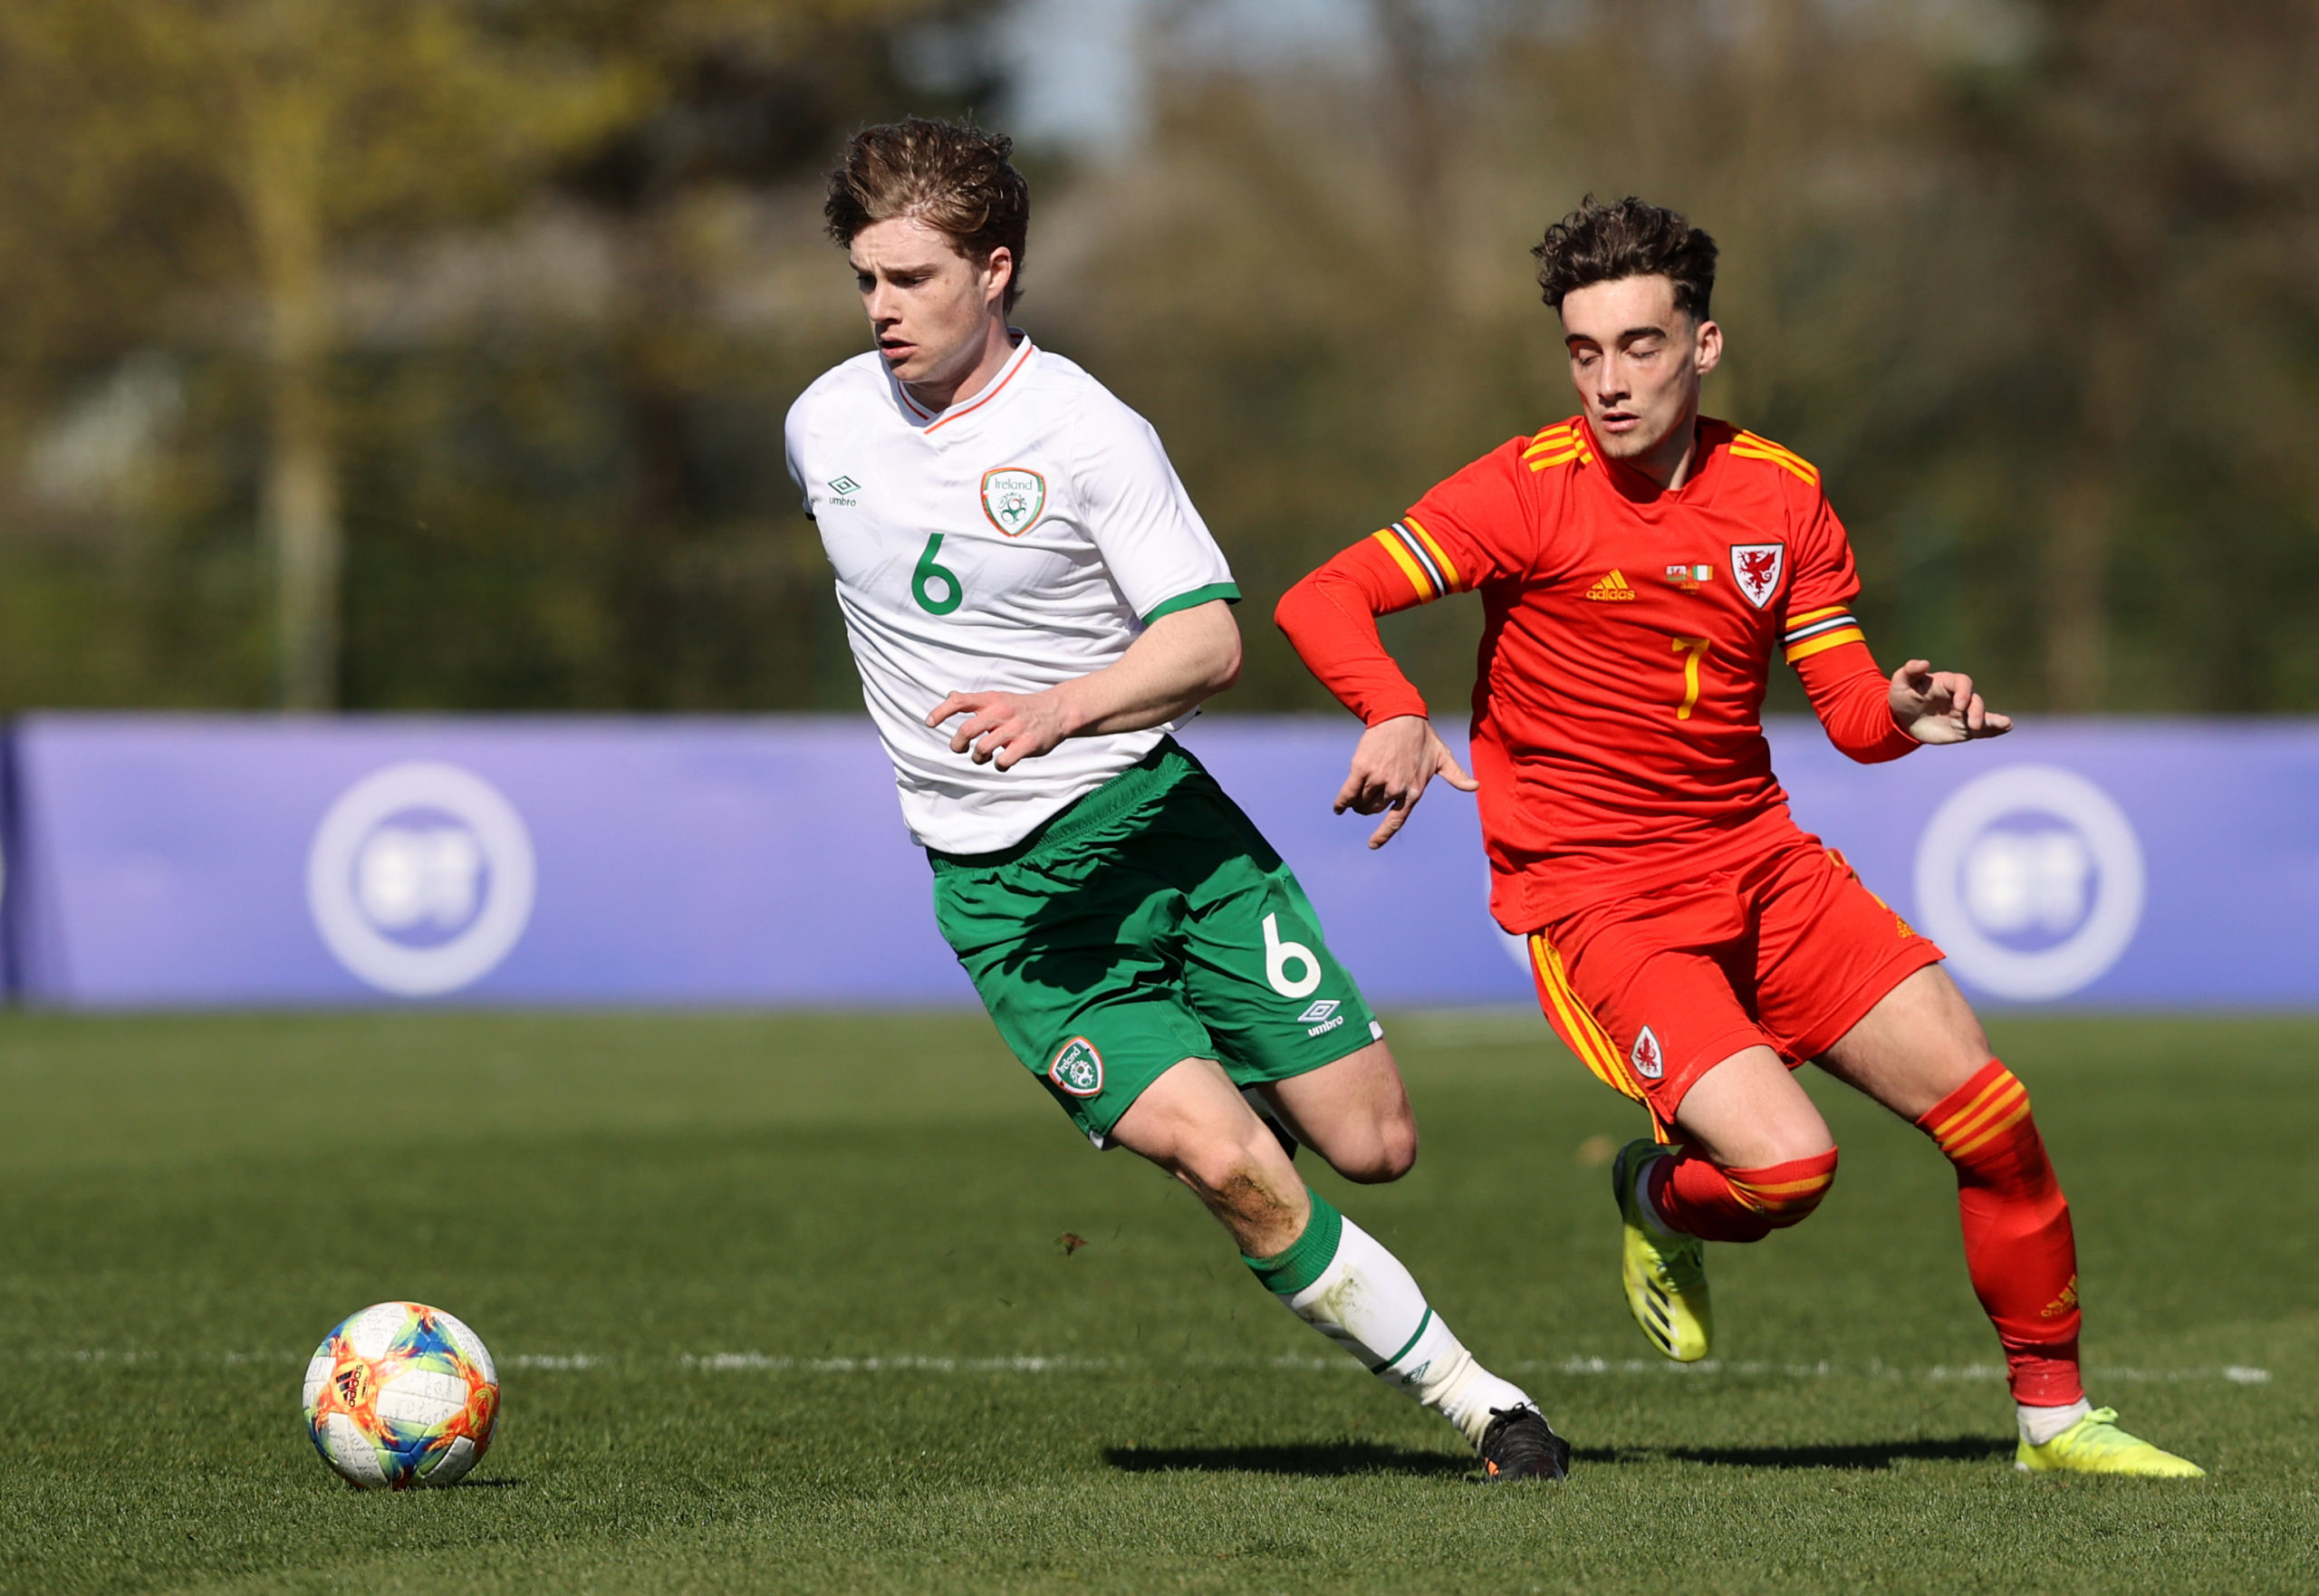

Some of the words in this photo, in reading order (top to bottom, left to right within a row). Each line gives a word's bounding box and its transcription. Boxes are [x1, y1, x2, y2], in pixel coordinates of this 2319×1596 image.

[995, 477, 1033, 490] Ireland
[829, 496, 856, 507] umbro
[910, 533, 962, 616] 6
[1586, 589, 1635, 601] adidas
[1671, 637, 1710, 720] 7
[1262, 911, 1322, 998] 6
[1308, 1015, 1343, 1037] umbro
[348, 1364, 363, 1408] adidas
